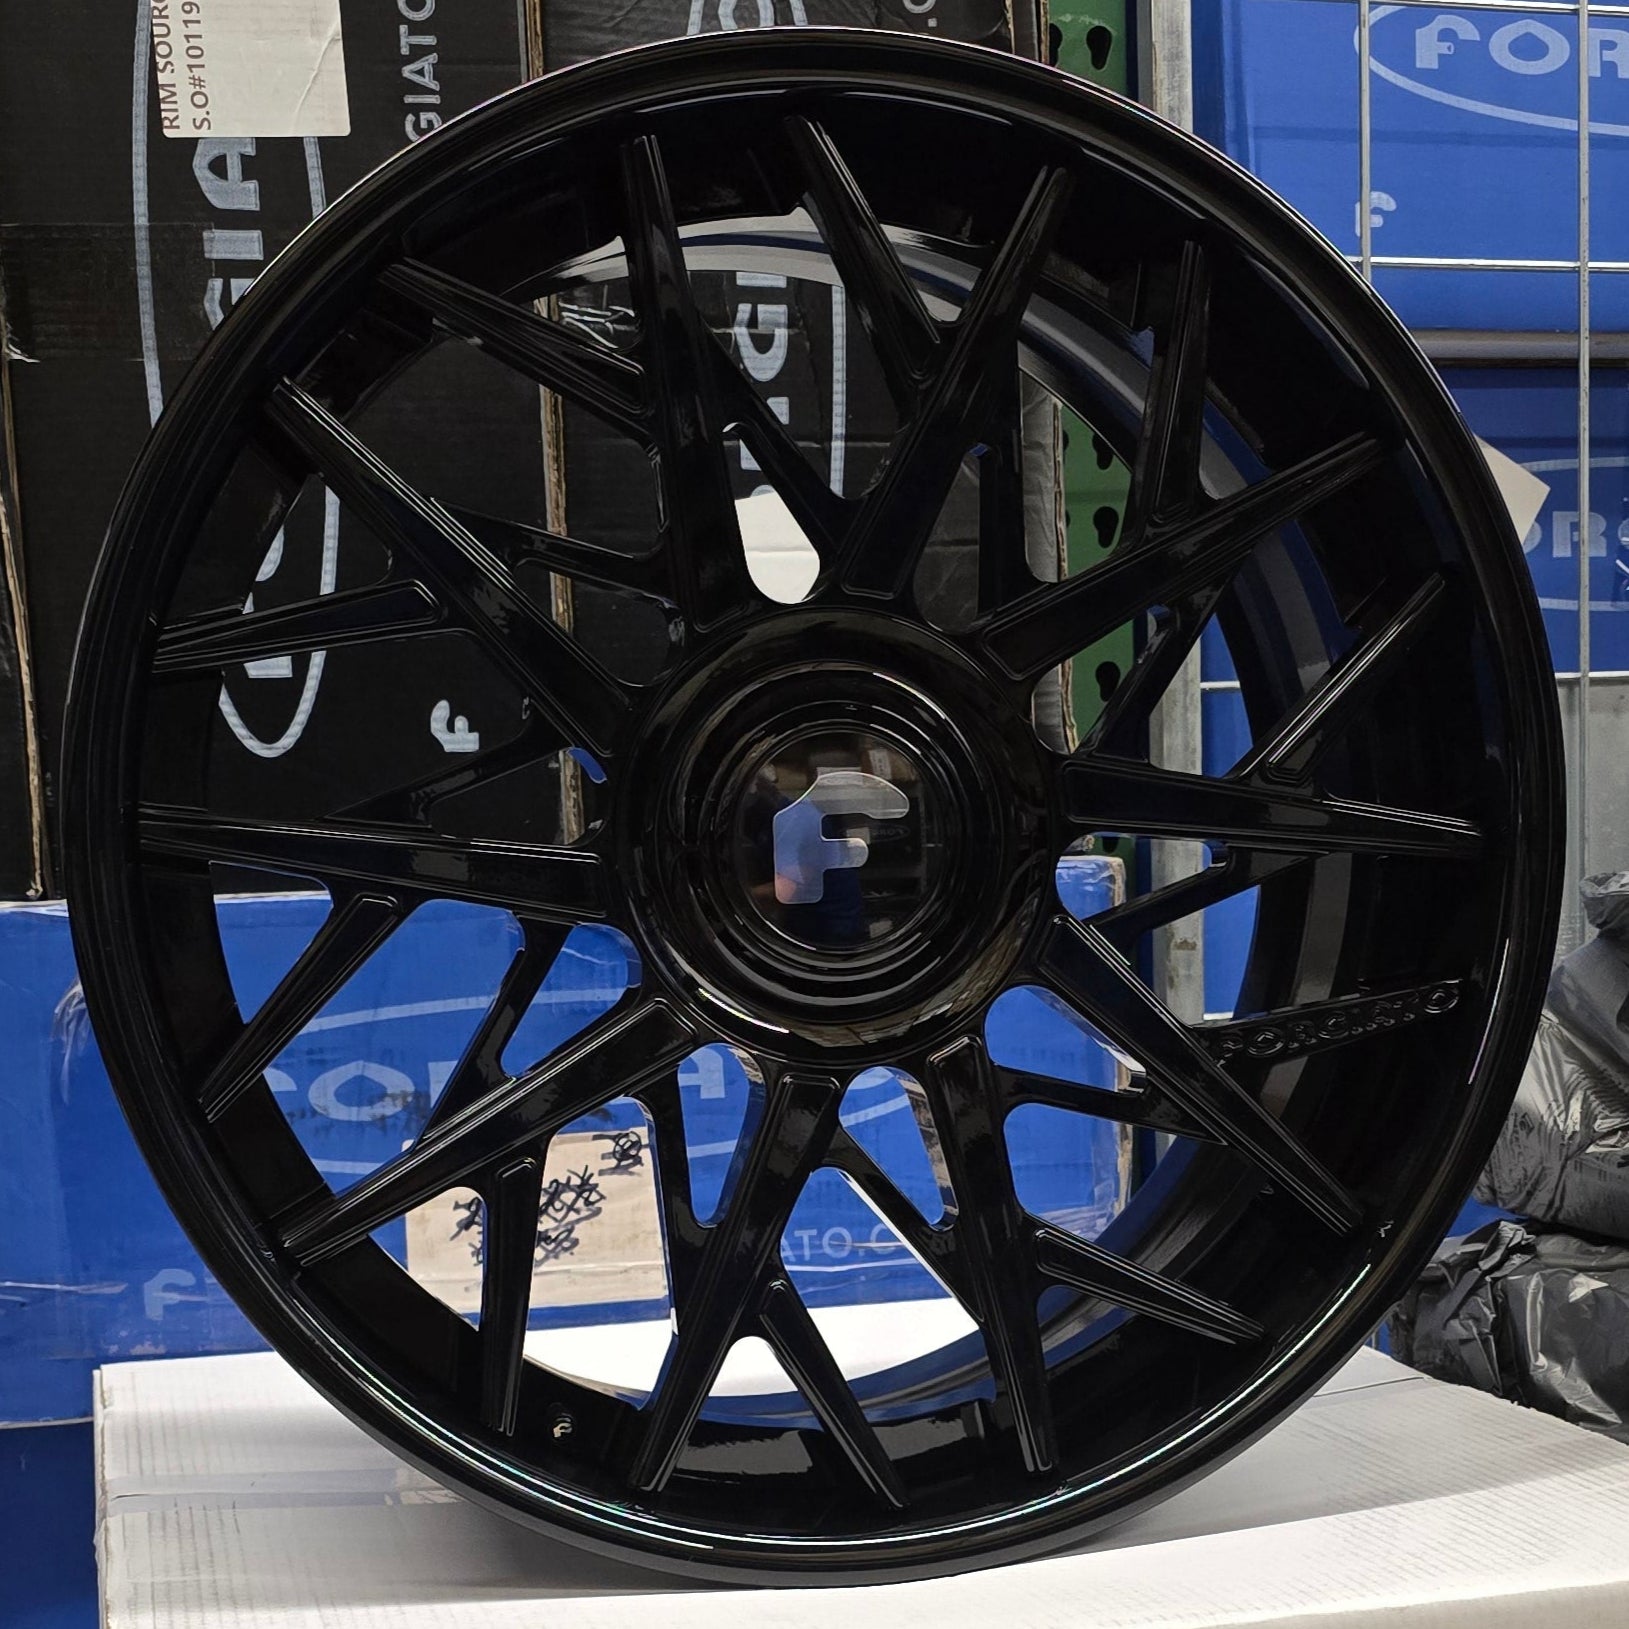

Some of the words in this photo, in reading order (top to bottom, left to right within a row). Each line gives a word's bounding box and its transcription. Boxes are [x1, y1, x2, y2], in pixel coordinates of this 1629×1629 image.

[152, 0, 175, 73] SOUR
[181, 1, 212, 131] S.O#10119
[1415, 14, 1629, 79] FOR
[159, 83, 180, 130] RIM
[430, 700, 480, 752] F
[773, 771, 909, 904] F
